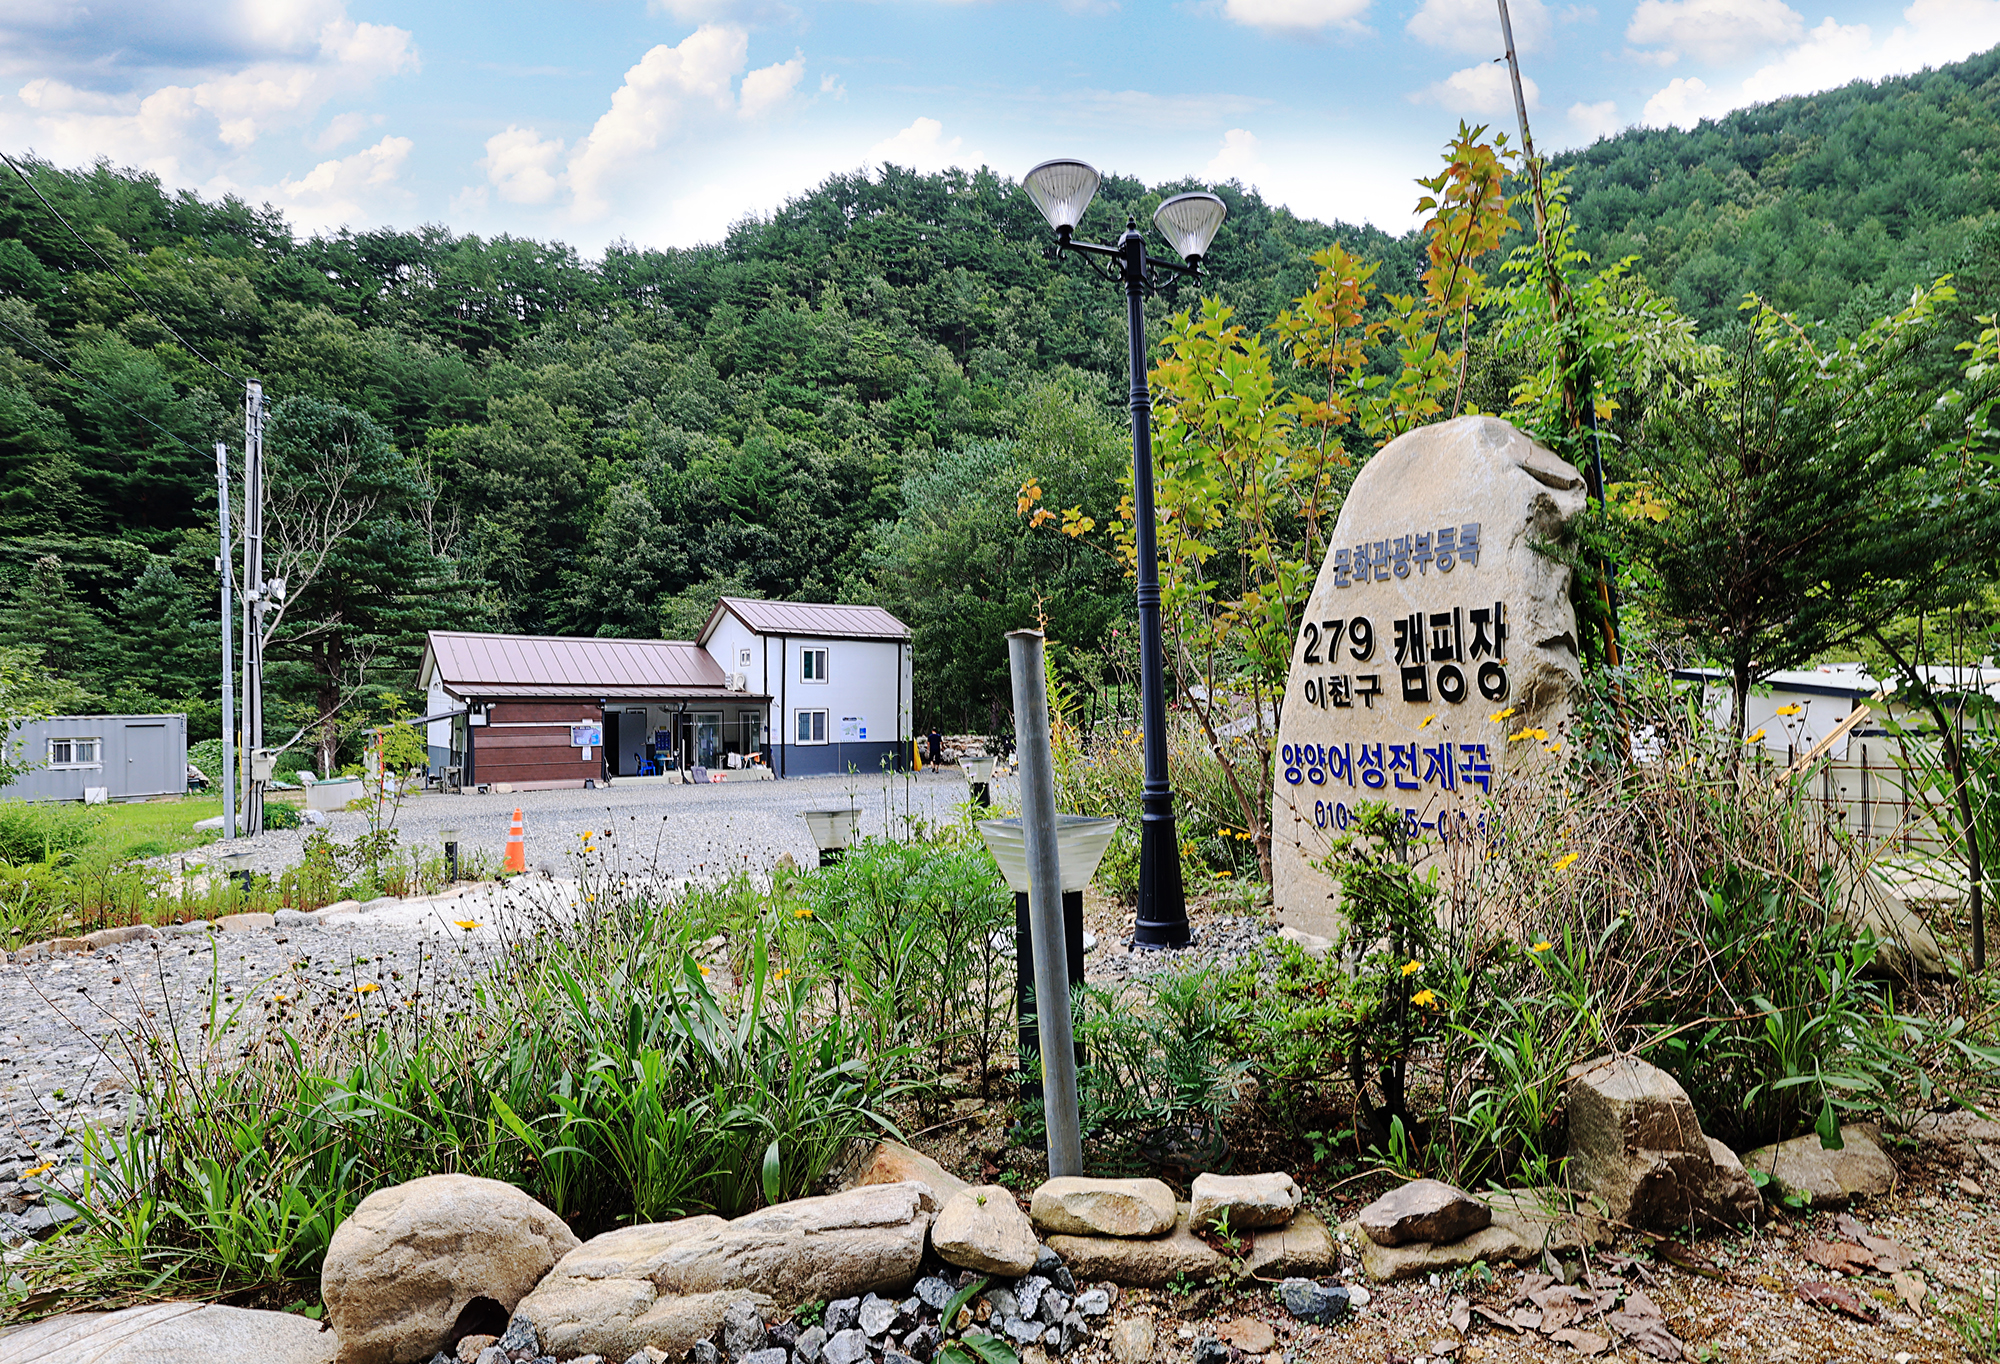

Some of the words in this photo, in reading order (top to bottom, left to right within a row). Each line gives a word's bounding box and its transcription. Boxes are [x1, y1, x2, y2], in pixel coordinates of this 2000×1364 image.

[1333, 522, 1481, 588] 문화관광부등록
[1303, 616, 1375, 664] 279
[1393, 601, 1510, 703] 캠핑장
[1304, 674, 1385, 709] 이친구
